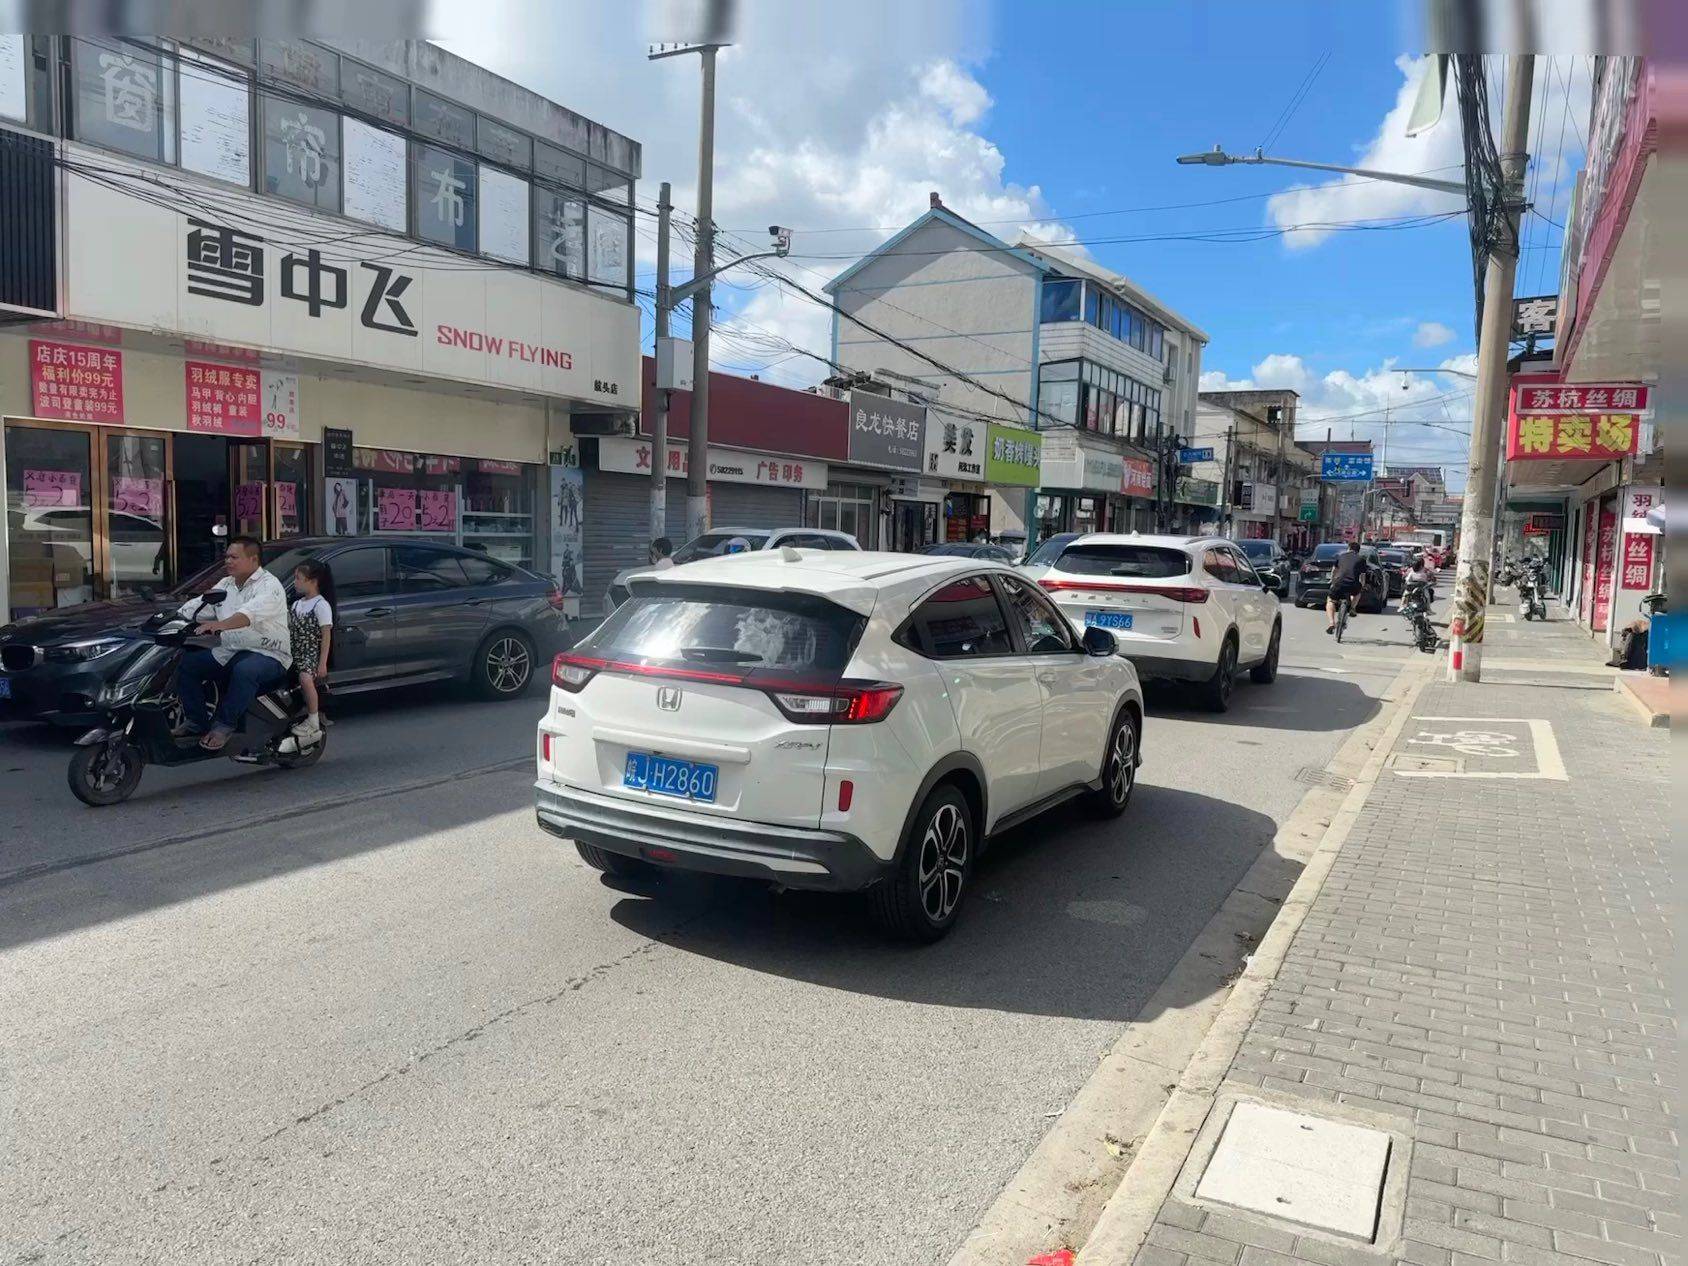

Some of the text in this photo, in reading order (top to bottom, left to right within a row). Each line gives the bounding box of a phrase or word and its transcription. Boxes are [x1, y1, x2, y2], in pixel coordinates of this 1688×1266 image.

[187, 217, 418, 337] 雪中飞
[1518, 299, 1557, 333] 客
[37, 344, 117, 371] 店庆15周年
[437, 324, 573, 370] SNOW FLYING
[42, 365, 114, 387] 福利价99元
[190, 367, 257, 390] 羽绒服专卖
[1531, 388, 1637, 408] 苏杭丝绸
[855, 408, 920, 441] 良龙快餐店
[1519, 413, 1633, 454] 特卖场
[756, 461, 779, 481] 广告
